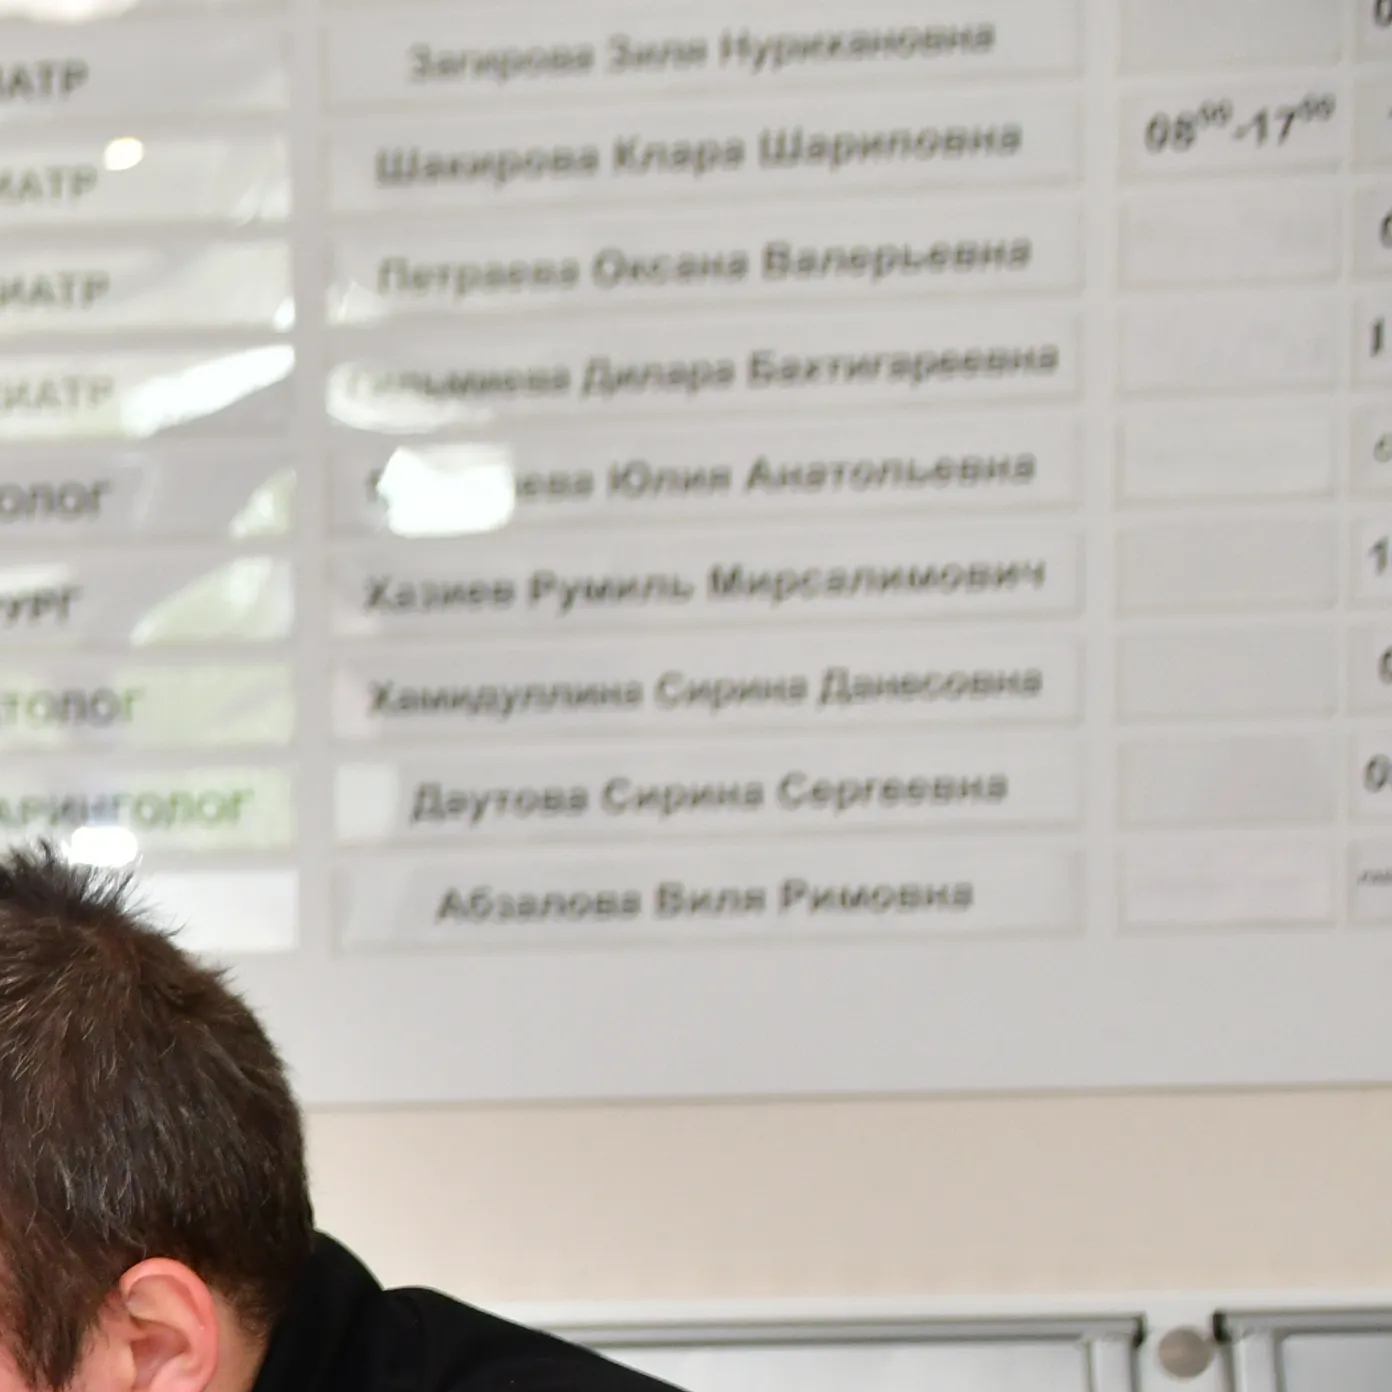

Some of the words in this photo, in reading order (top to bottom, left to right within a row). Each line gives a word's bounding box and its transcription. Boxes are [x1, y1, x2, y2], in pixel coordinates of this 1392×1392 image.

[374, 146, 599, 190] Шакирова
[612, 134, 745, 180] Клара
[590, 248, 749, 288] Оксана
[762, 238, 1032, 285] Валерьевна
[579, 356, 736, 402] Дилара
[609, 459, 731, 500] Юлия
[743, 452, 1036, 496] Анатольевна
[528, 568, 695, 616] Румиль
[708, 560, 1046, 610] Мирсалимович
[654, 668, 808, 716] Сирина
[410, 780, 589, 826] Даутова
[601, 775, 764, 822] Сирина
[776, 770, 1009, 816] Сергеевна
[435, 886, 641, 926] Абзалова
[776, 876, 974, 918] Римовна
